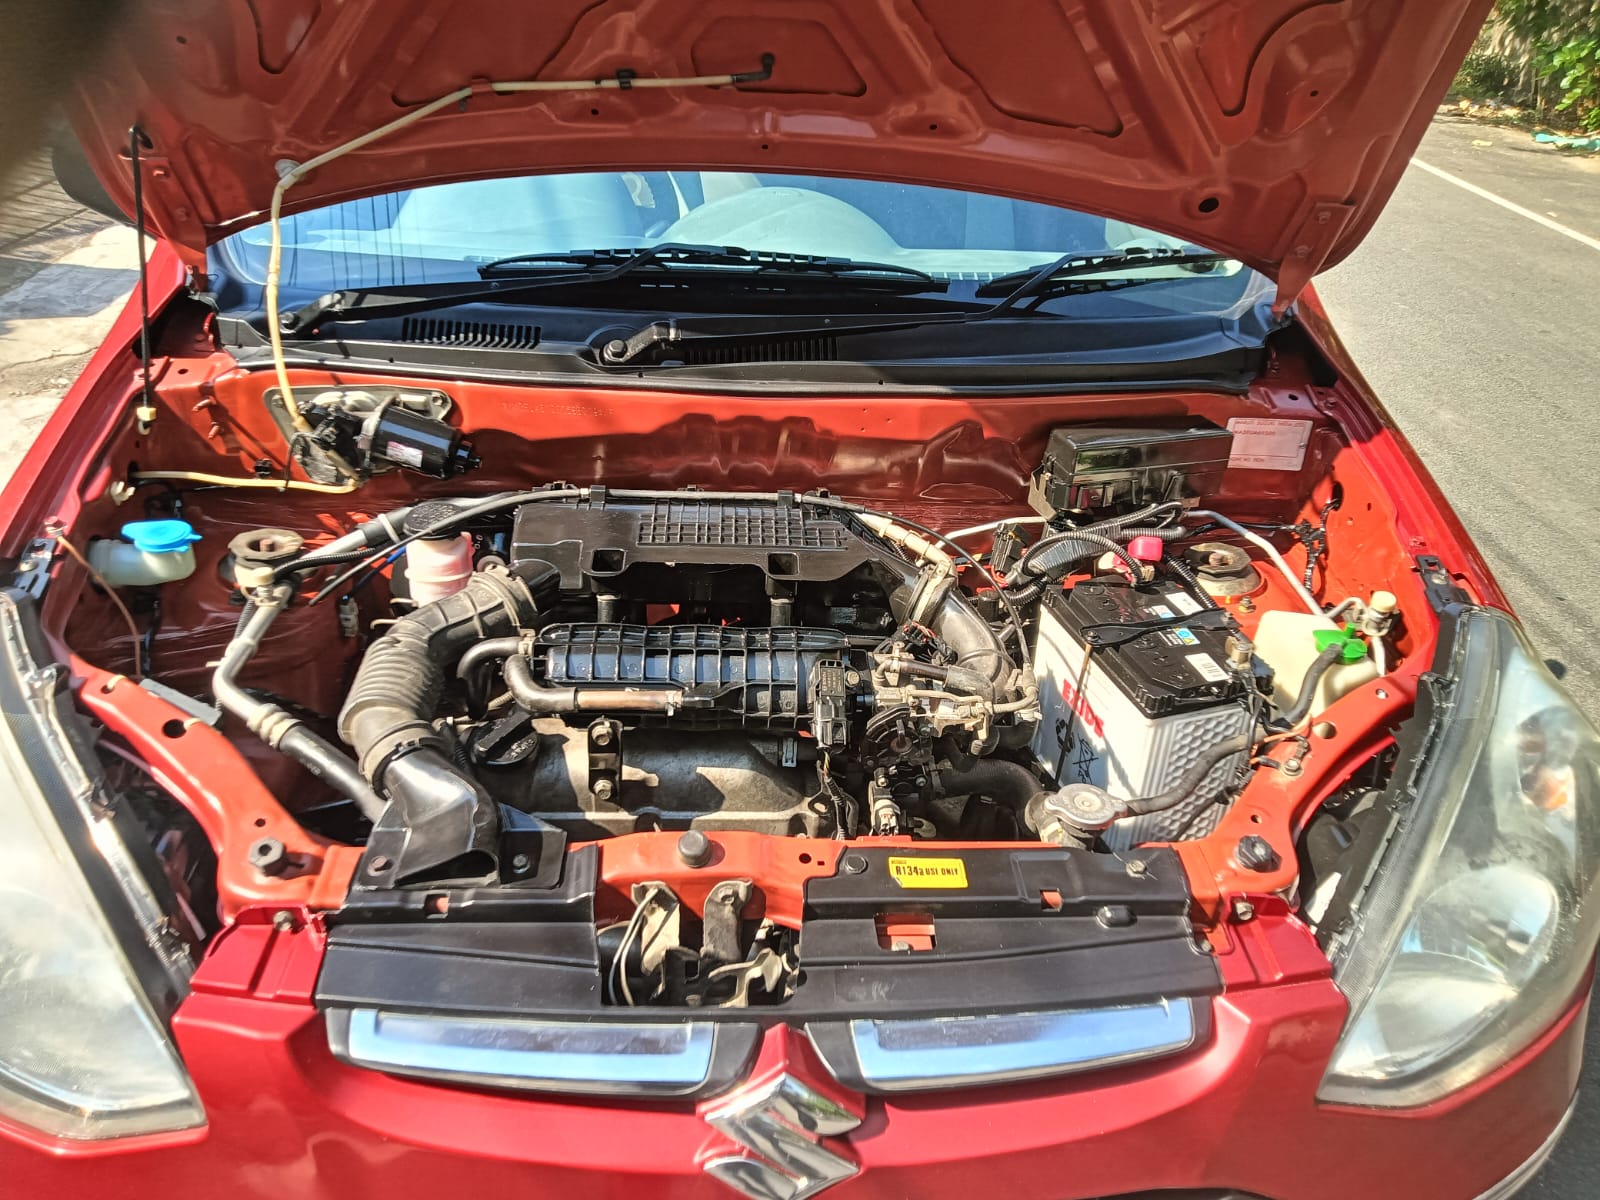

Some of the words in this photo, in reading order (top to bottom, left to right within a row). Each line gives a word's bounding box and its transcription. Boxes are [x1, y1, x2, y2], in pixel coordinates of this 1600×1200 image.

[1062, 678, 1104, 738] EXIDE
[895, 865, 924, 876] R134a
[925, 867, 938, 876] USE
[941, 868, 958, 876] ONLY
